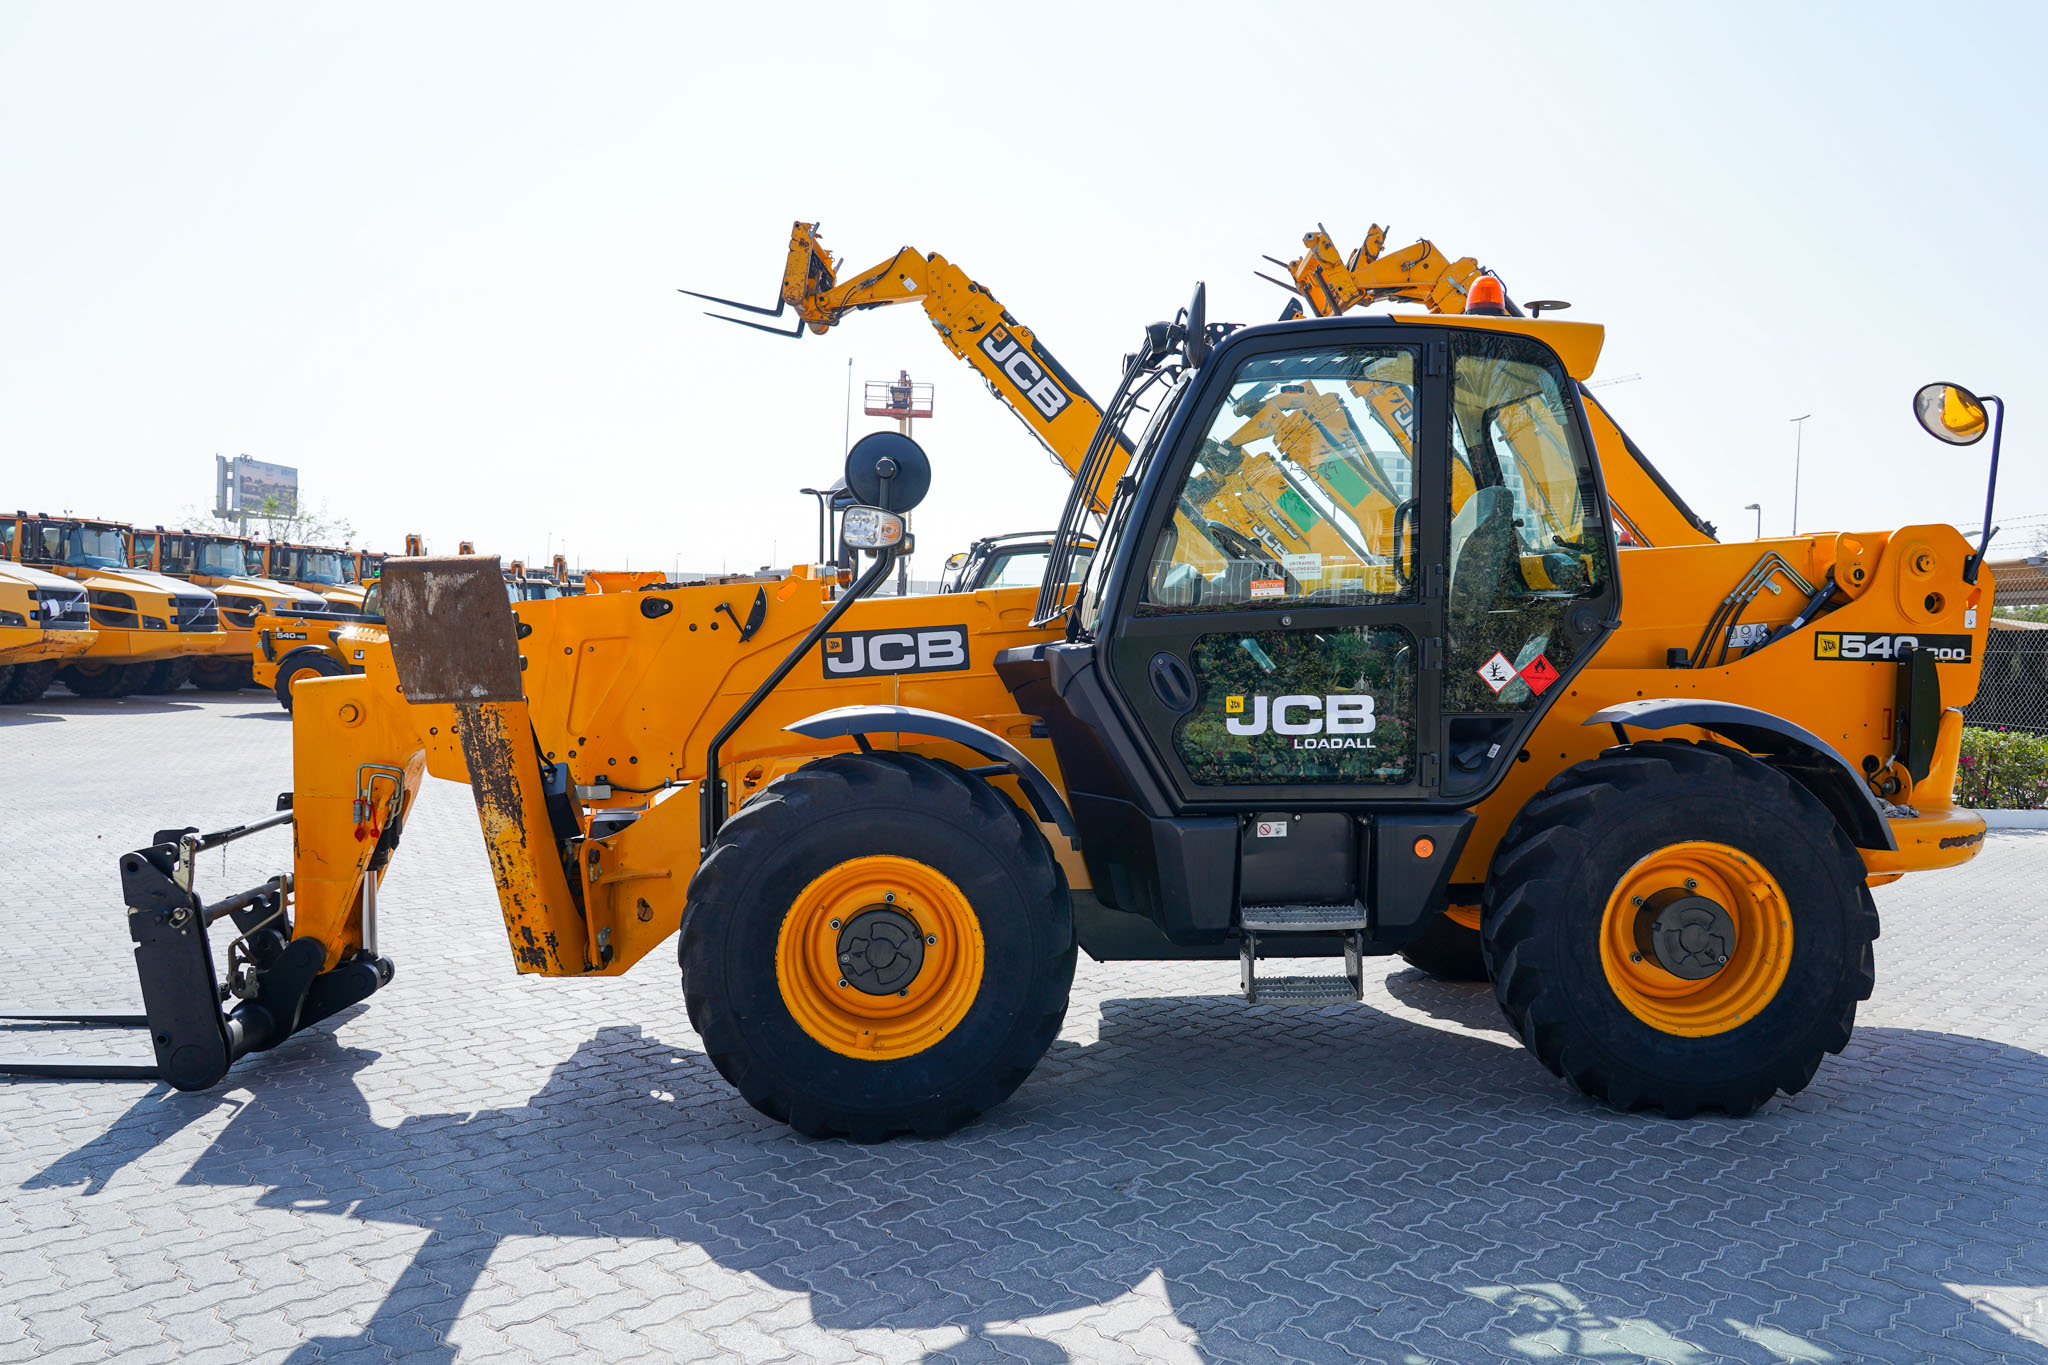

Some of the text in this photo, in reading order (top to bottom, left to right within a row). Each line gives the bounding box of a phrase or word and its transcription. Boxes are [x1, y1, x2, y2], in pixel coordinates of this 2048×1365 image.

[983, 337, 1066, 417] JCB
[1252, 581, 1284, 589] Thatcham
[827, 631, 965, 673] JCB
[1226, 694, 1376, 736] JCB
[1293, 738, 1376, 749] LOADALL
